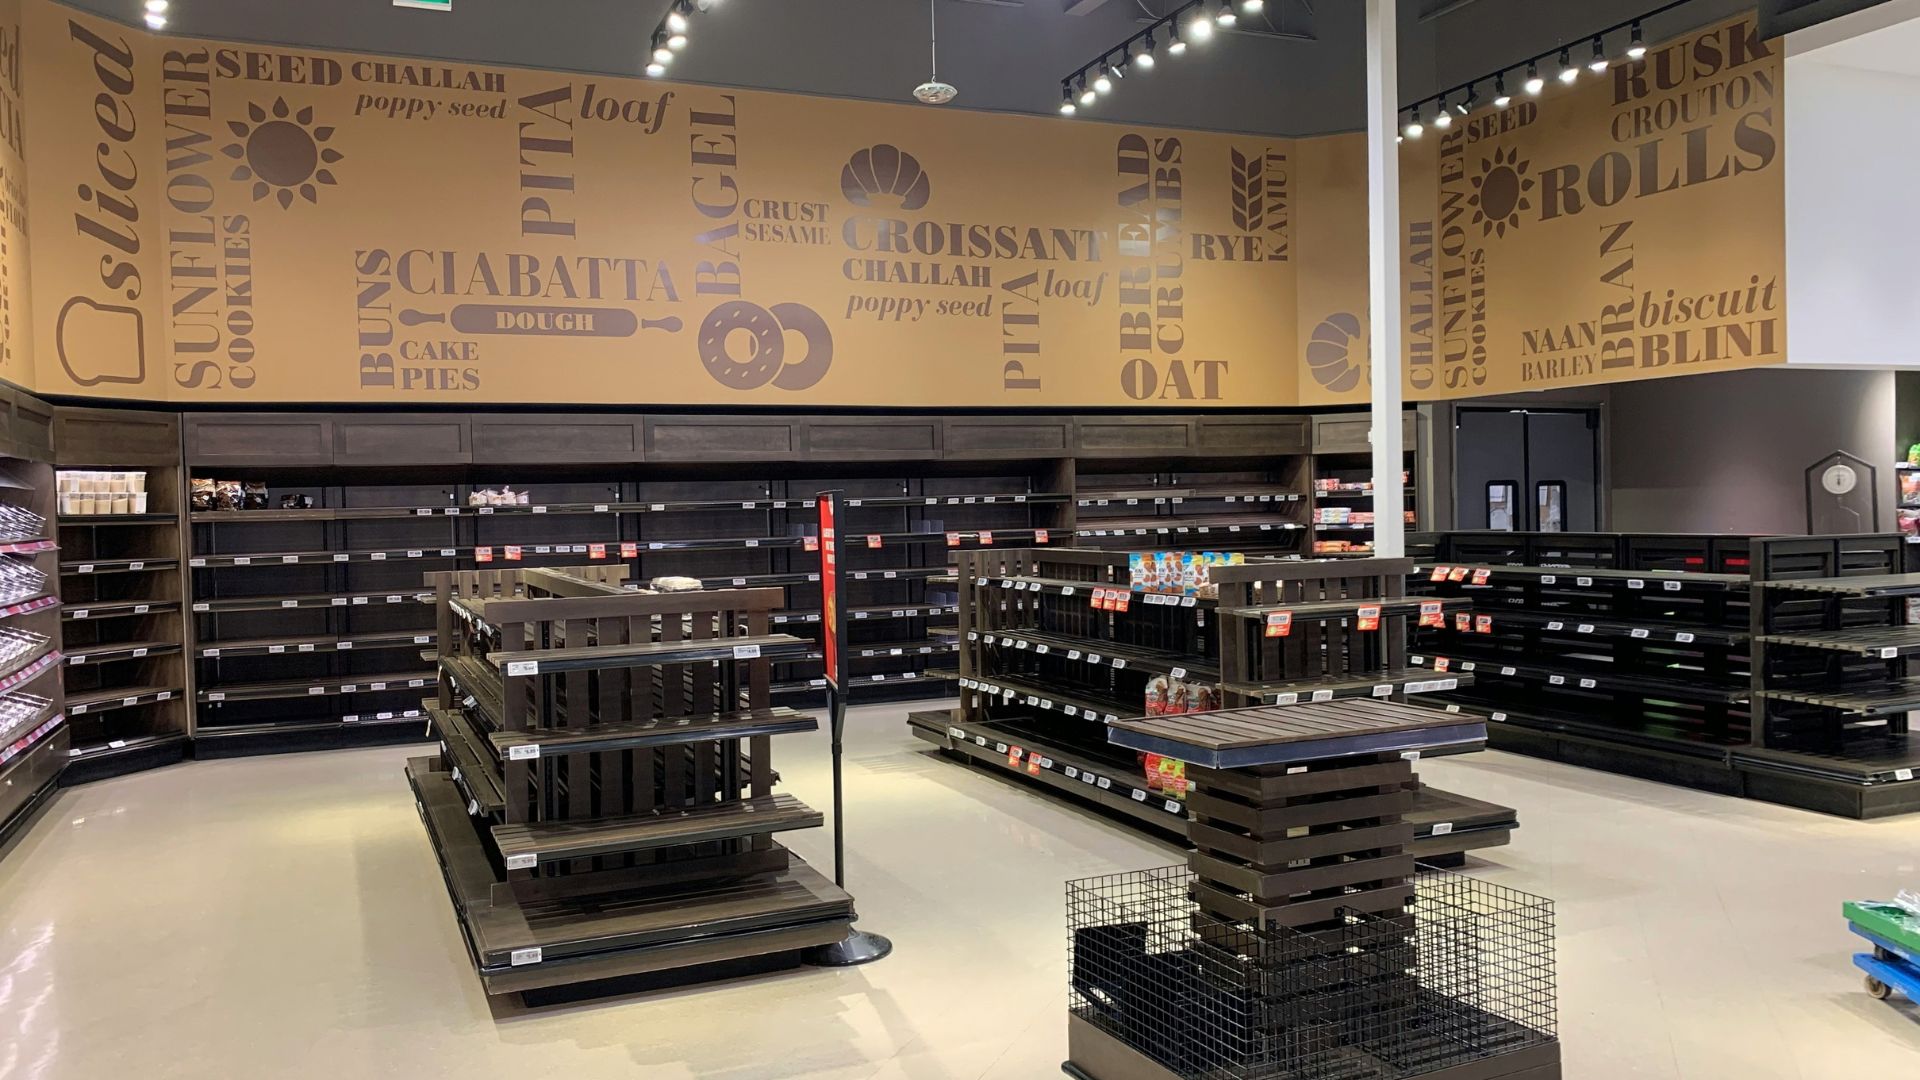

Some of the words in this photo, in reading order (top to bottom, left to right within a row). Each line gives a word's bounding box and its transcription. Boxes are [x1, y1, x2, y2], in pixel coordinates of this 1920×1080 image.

[215, 49, 342, 86] SEED
[351, 61, 506, 93] CHALLAH
[1612, 20, 1775, 106] RUSK
[355, 93, 442, 121] poppy
[448, 98, 508, 120] seed
[580, 83, 673, 134] loaf
[1467, 101, 1537, 144] SEED
[1611, 65, 1775, 143] CROUTON
[68, 19, 142, 300] sliced
[517, 83, 577, 240] PITA
[1537, 108, 1776, 221] ROLLS
[163, 46, 222, 390] SUNFLOWER
[690, 96, 740, 297] BAGEL
[744, 198, 830, 223] CRUST
[1266, 148, 1288, 262] KAMUT
[744, 223, 831, 245] SESAME
[841, 214, 1108, 262] CROISSANT
[1117, 133, 1152, 353] BREAD
[1156, 137, 1184, 355] CRUMBS
[1190, 233, 1264, 262] RYE
[1440, 125, 1468, 388] SUNFLOWER
[397, 249, 680, 301] CIABATTA
[842, 258, 992, 288] CHALLAH
[1044, 270, 1108, 306] loaf
[1600, 220, 1634, 373] BRAN
[222, 214, 256, 388] COOKIES
[354, 248, 395, 389] BUNS
[496, 310, 595, 331] DOUGH
[846, 292, 931, 322] poppy
[936, 294, 993, 318] seed
[1410, 219, 1433, 389] CHALLAH
[1470, 248, 1486, 385] COOKIES
[1640, 275, 1777, 329] biscuit
[400, 340, 479, 360] CAKE
[1003, 270, 1040, 392] PITA
[1522, 321, 1596, 356] NAAN
[1640, 318, 1777, 368] BLINI
[401, 367, 480, 390] PIES
[1120, 359, 1228, 400] OAT
[1522, 353, 1597, 382] BARLEY
